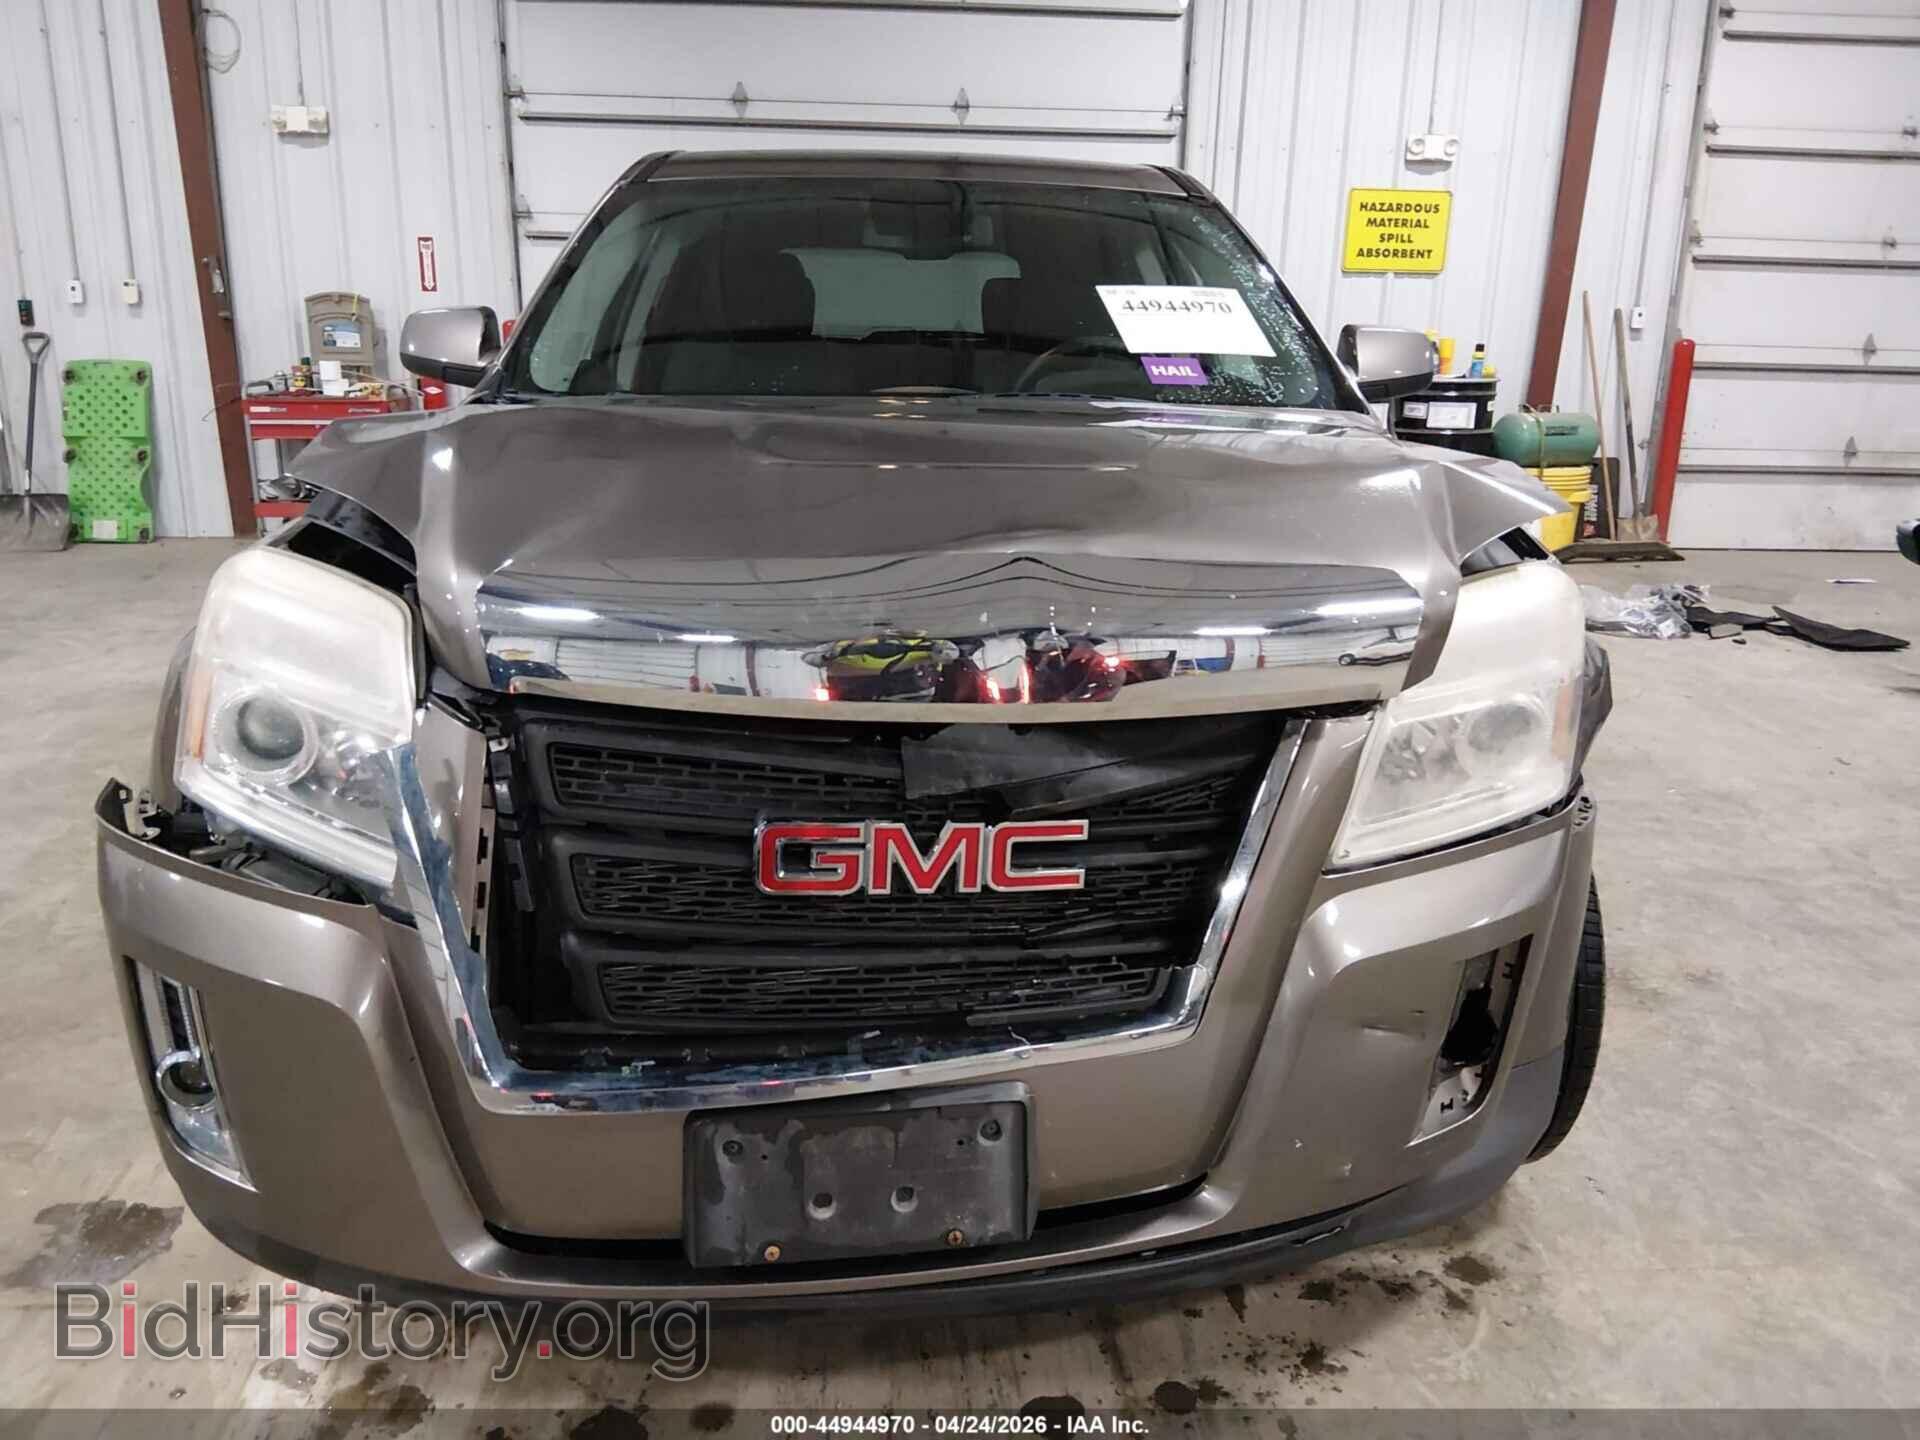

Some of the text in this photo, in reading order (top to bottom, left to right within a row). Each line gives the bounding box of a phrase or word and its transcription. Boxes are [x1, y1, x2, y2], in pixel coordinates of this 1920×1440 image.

[1359, 202, 1440, 214] HAZARDOUS
[1366, 217, 1430, 229] MATERIAL
[1379, 233, 1414, 244] SPILL
[1356, 248, 1433, 259] ABSORBENT
[1122, 299, 1233, 314] 44944970
[1149, 364, 1199, 378] HAIL
[755, 817, 1089, 897] GMC
